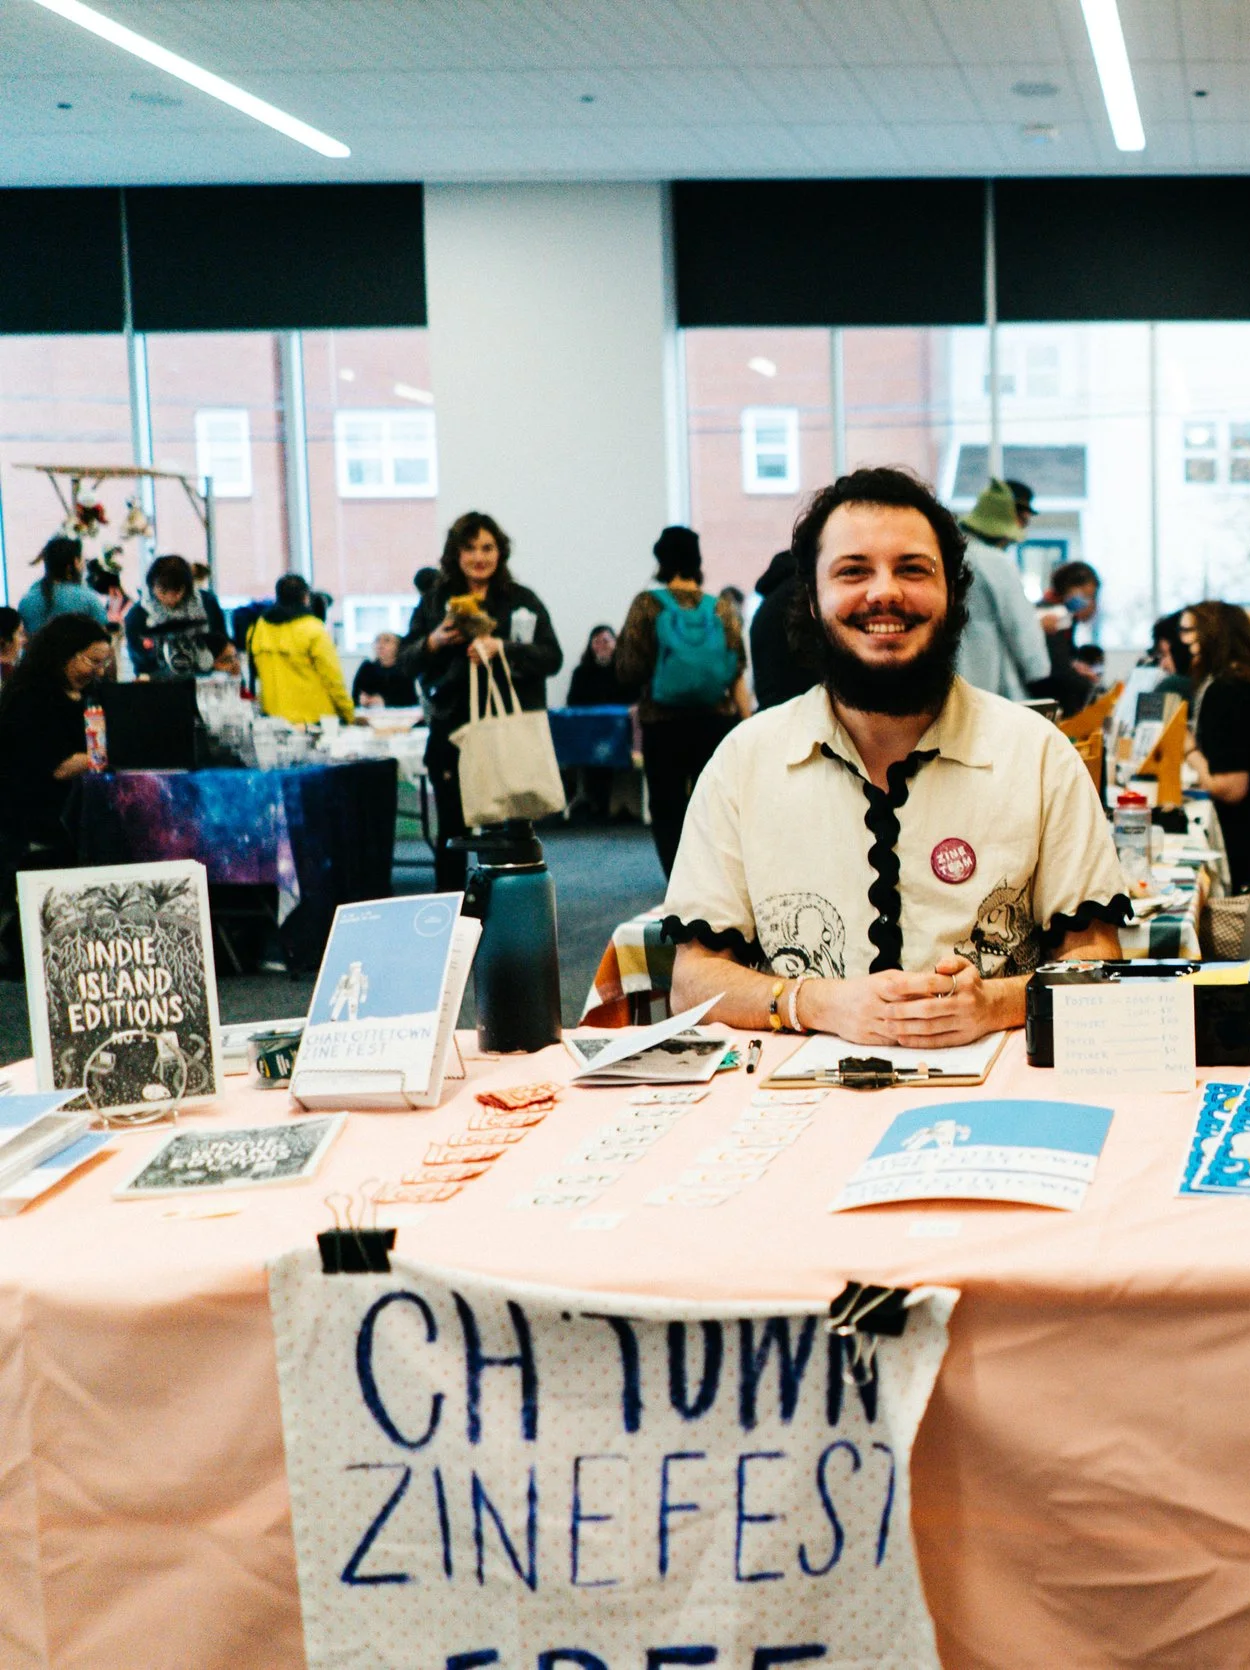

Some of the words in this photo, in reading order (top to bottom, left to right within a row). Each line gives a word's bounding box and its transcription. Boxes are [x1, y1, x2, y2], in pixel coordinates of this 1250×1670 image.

[86, 936, 157, 969] INDIE
[77, 966, 173, 1002] ISLAND
[67, 995, 184, 1034] EDITIONS
[302, 1043, 339, 1061] ZINE
[347, 1042, 389, 1058] FEST
[305, 1025, 432, 1047] CHARLOTTETOWN
